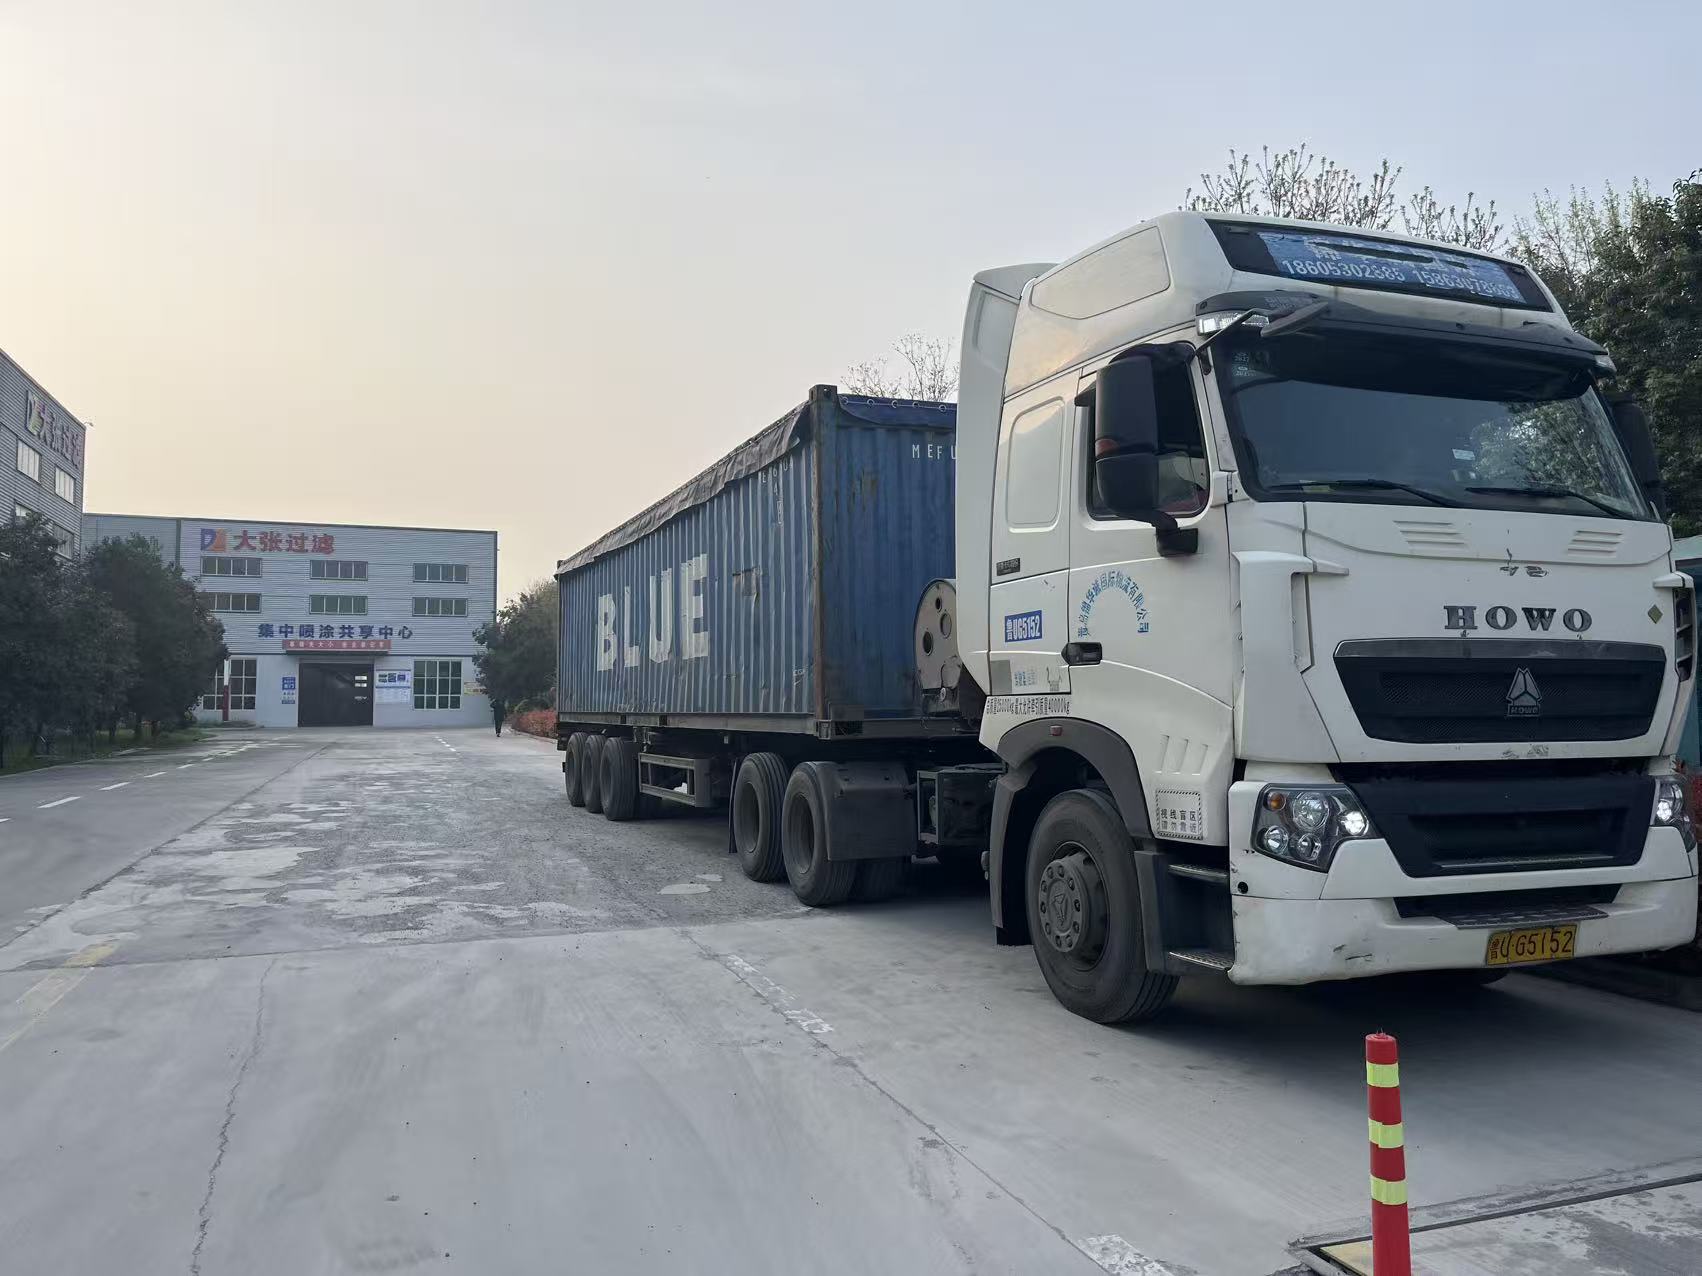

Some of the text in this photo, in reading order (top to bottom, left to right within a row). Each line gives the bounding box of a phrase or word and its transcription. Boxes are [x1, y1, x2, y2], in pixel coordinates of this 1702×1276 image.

[233, 529, 335, 554] 大张过滤
[597, 553, 709, 671] BLUE
[1443, 605, 1593, 633] HOWO
[258, 623, 413, 640] 集中喷涂共享中心
[1006, 615, 1041, 640] 鲁UG5152
[1511, 704, 1539, 714] HOWO
[1161, 809, 1196, 821] 视线盲区
